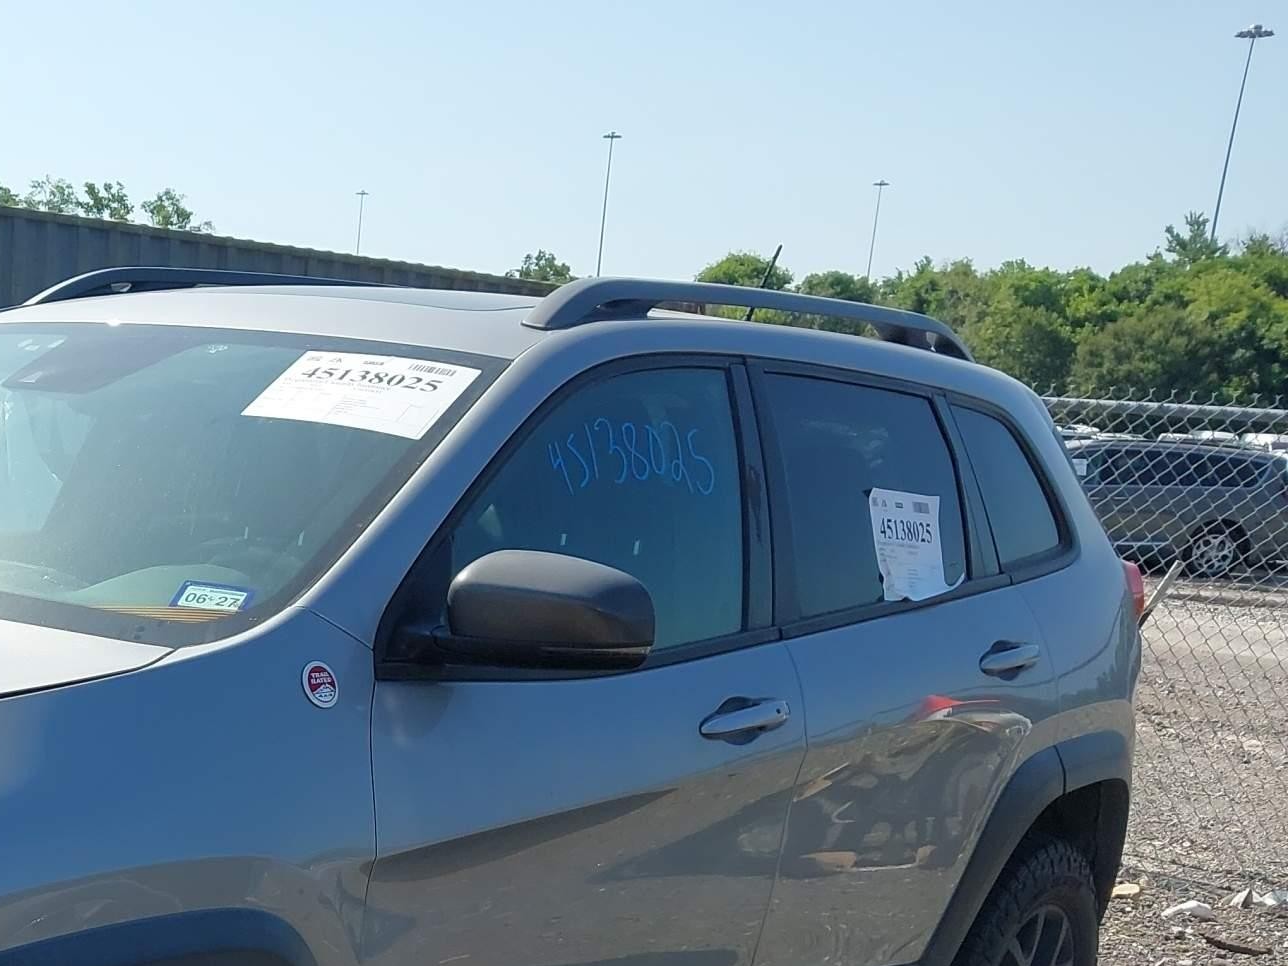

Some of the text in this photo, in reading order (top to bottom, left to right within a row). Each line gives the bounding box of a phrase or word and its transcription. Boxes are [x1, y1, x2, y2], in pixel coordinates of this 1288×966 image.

[299, 365, 445, 393] 45138025
[547, 416, 715, 496] 45138025
[879, 516, 933, 544] 45138025
[184, 592, 208, 605] 06
[214, 595, 240, 608] 27
